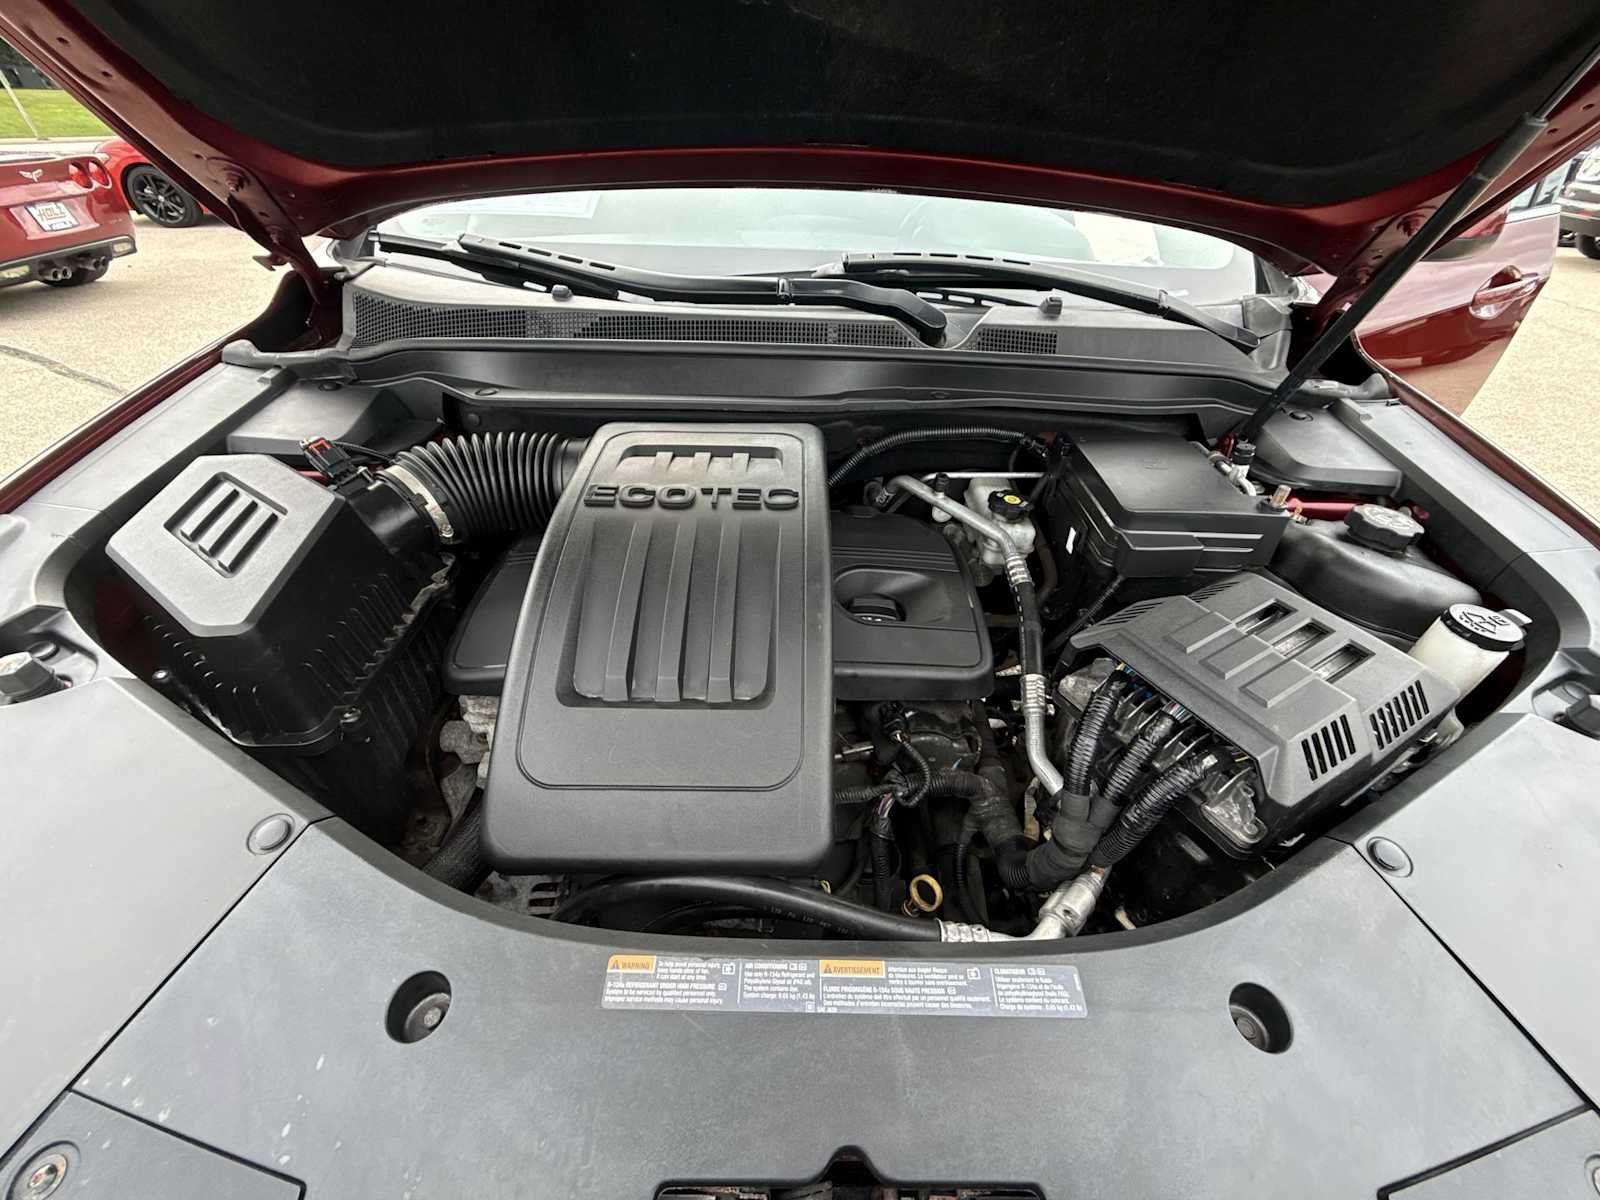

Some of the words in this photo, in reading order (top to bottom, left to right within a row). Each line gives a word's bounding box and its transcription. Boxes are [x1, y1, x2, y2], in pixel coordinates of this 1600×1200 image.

[584, 486, 798, 511] ECOTEC
[622, 960, 650, 969] WARNING
[833, 966, 879, 974] AVERTISSEMENT
